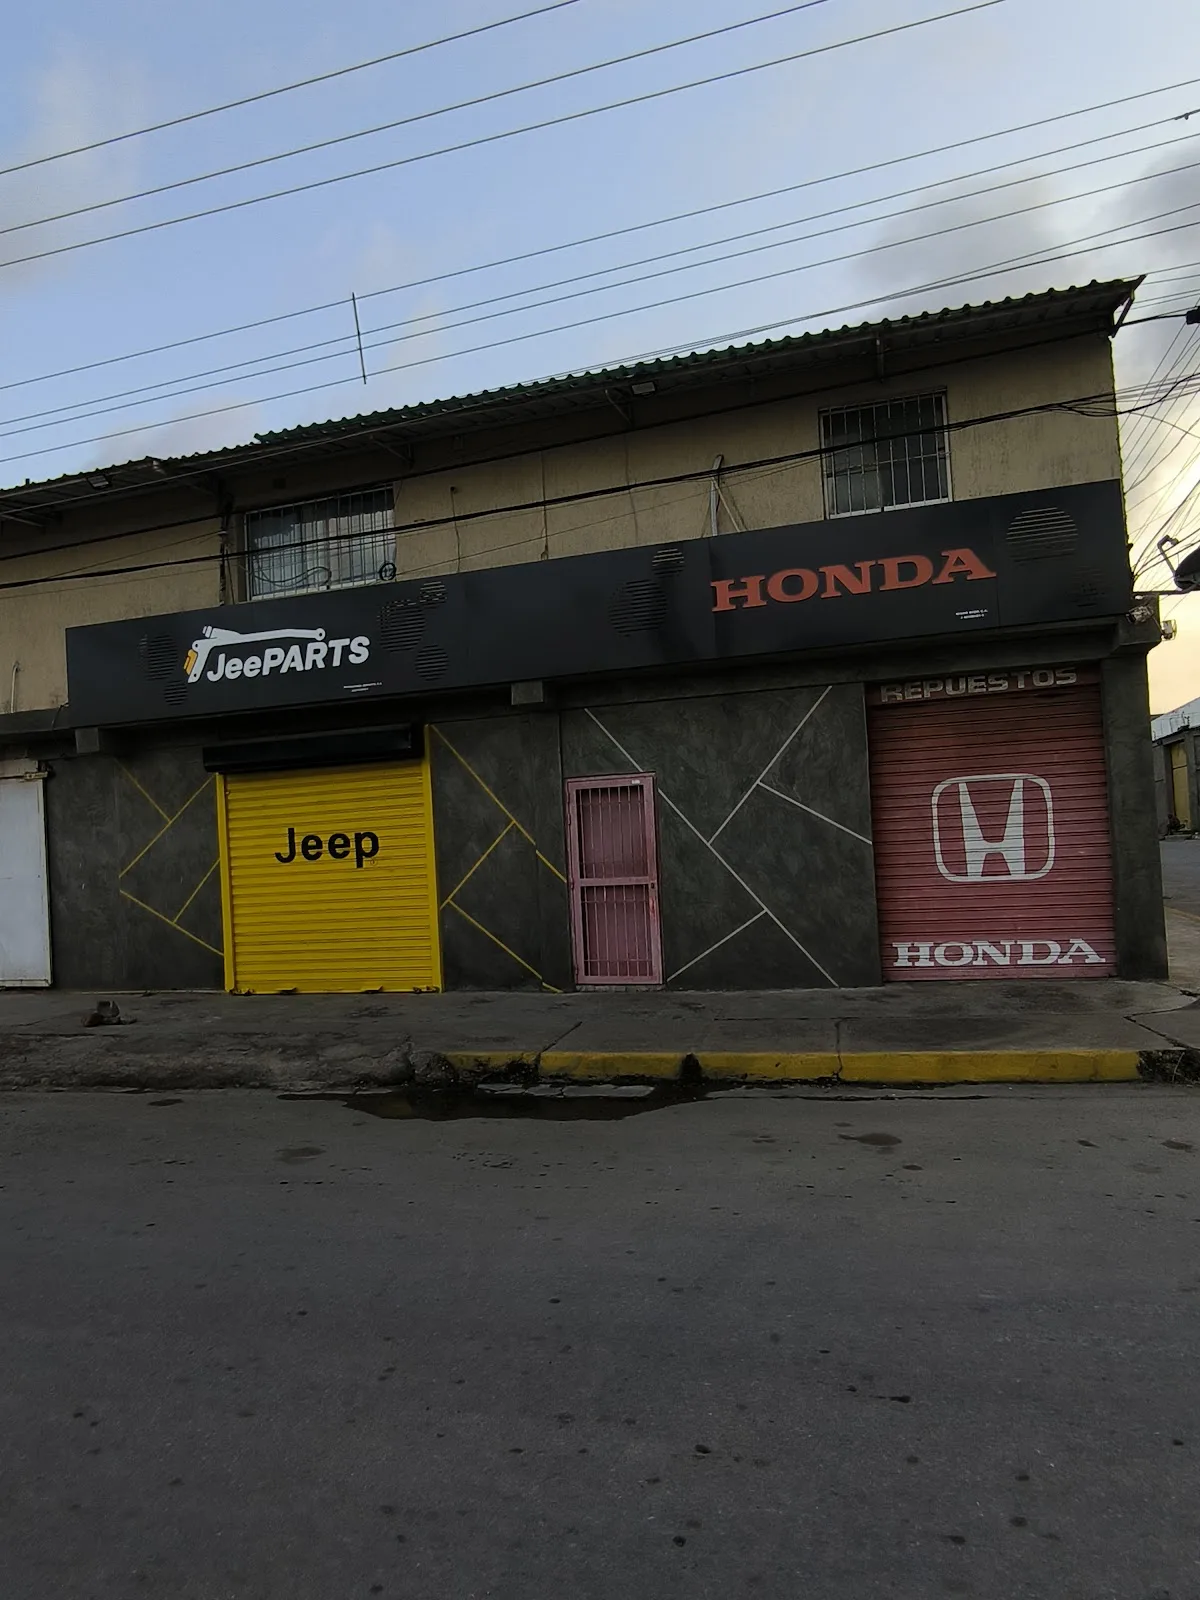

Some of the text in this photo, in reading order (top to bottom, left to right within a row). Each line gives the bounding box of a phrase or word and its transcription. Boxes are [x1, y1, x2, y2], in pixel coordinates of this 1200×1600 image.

[711, 548, 997, 612] HONDA
[206, 636, 370, 682] JeePARTS
[880, 667, 1078, 702] REPUESTOS
[274, 827, 380, 869] Jeep
[892, 938, 1106, 967] HONDA
